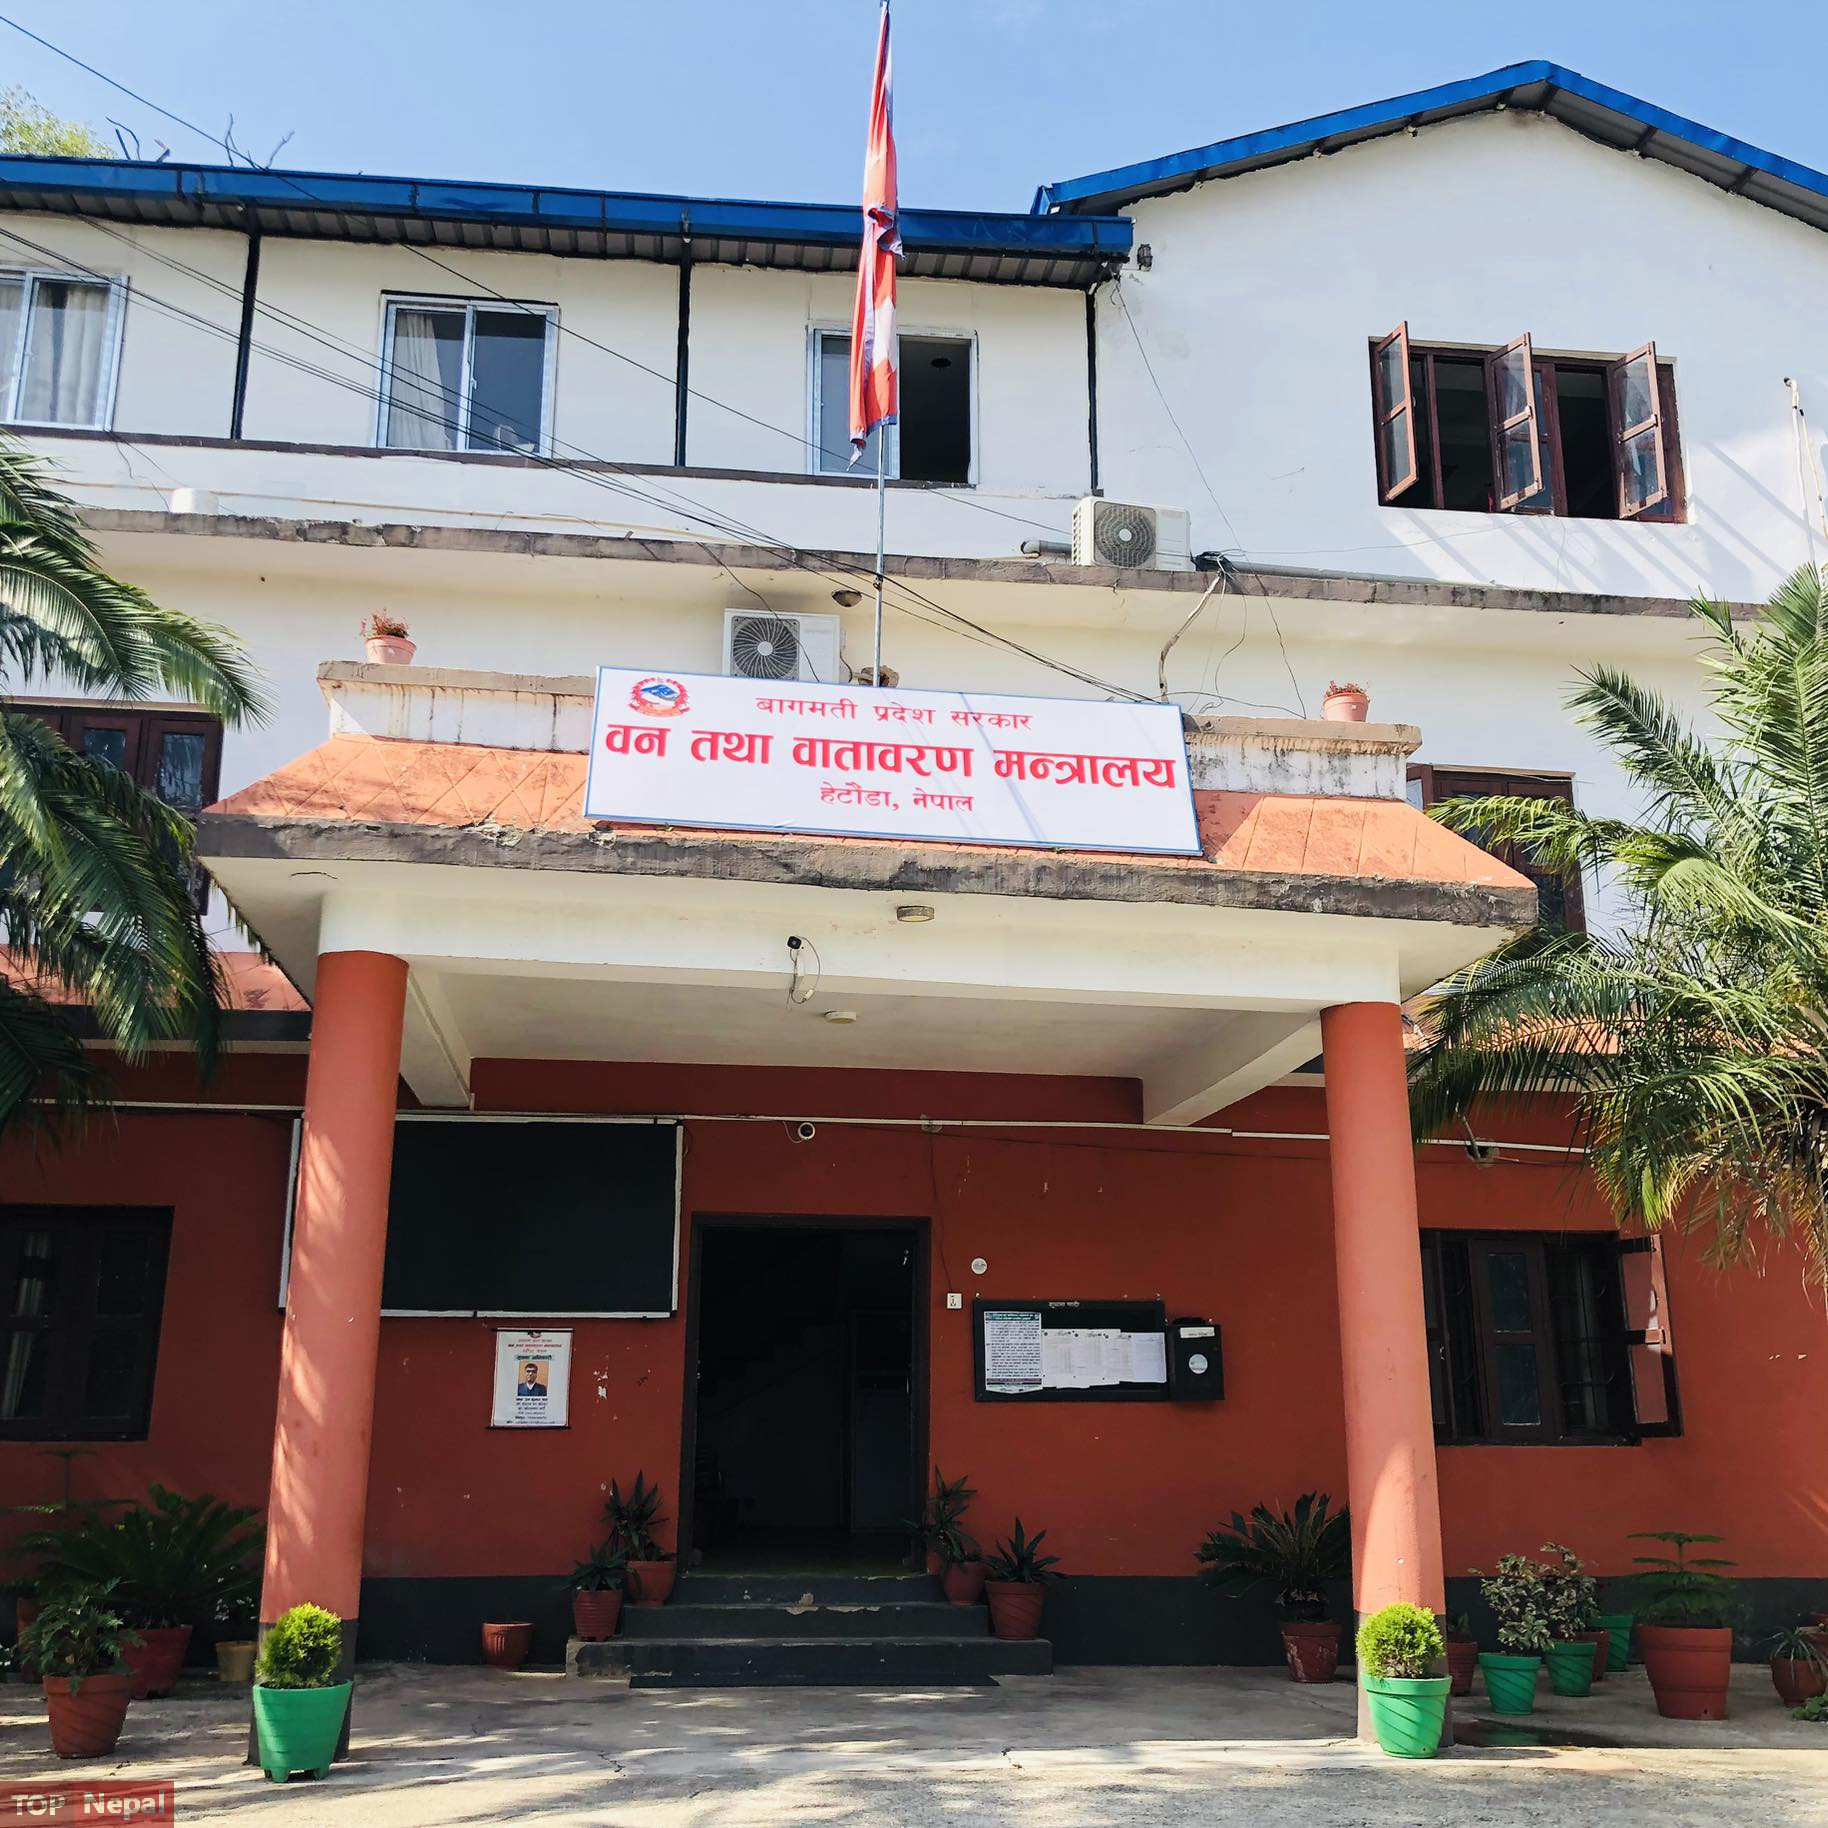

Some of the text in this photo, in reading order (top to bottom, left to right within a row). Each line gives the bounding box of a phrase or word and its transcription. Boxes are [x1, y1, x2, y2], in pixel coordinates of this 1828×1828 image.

[756, 697, 1033, 730] बागमती प्रदेश सरकार
[605, 724, 1177, 788] वन तथा वातावरण मन्त्रालय
[912, 787, 975, 811] नेपाल
